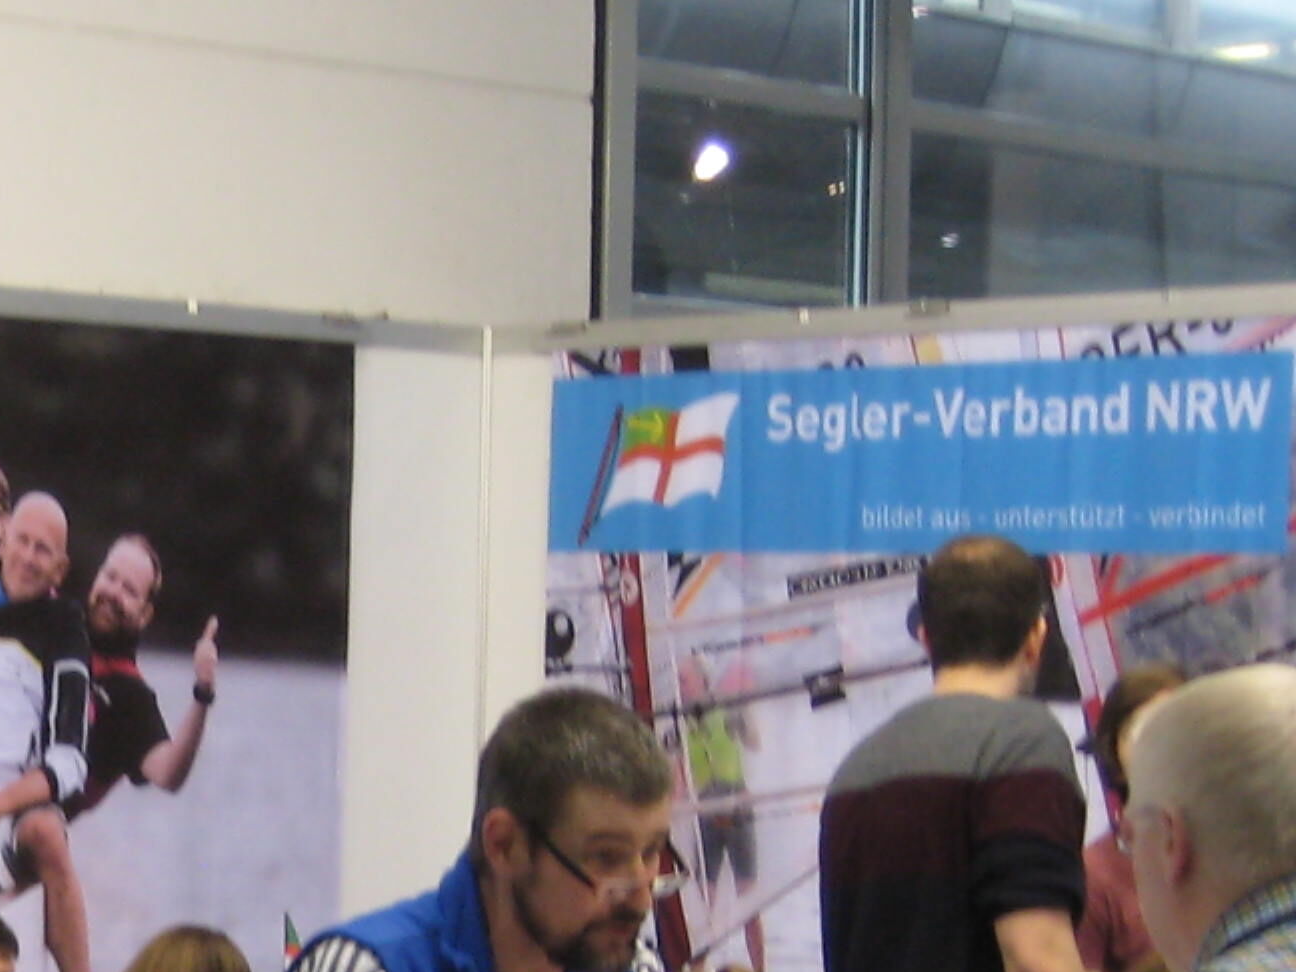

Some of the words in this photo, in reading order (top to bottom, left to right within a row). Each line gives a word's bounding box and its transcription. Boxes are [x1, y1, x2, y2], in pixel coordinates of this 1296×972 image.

[766, 382, 1131, 452] Segler-Verband
[1146, 378, 1272, 431] NRW
[862, 503, 923, 530] bildet
[931, 508, 969, 528] aus
[995, 503, 1127, 529] unterstützt
[1149, 502, 1267, 529] verbindet
